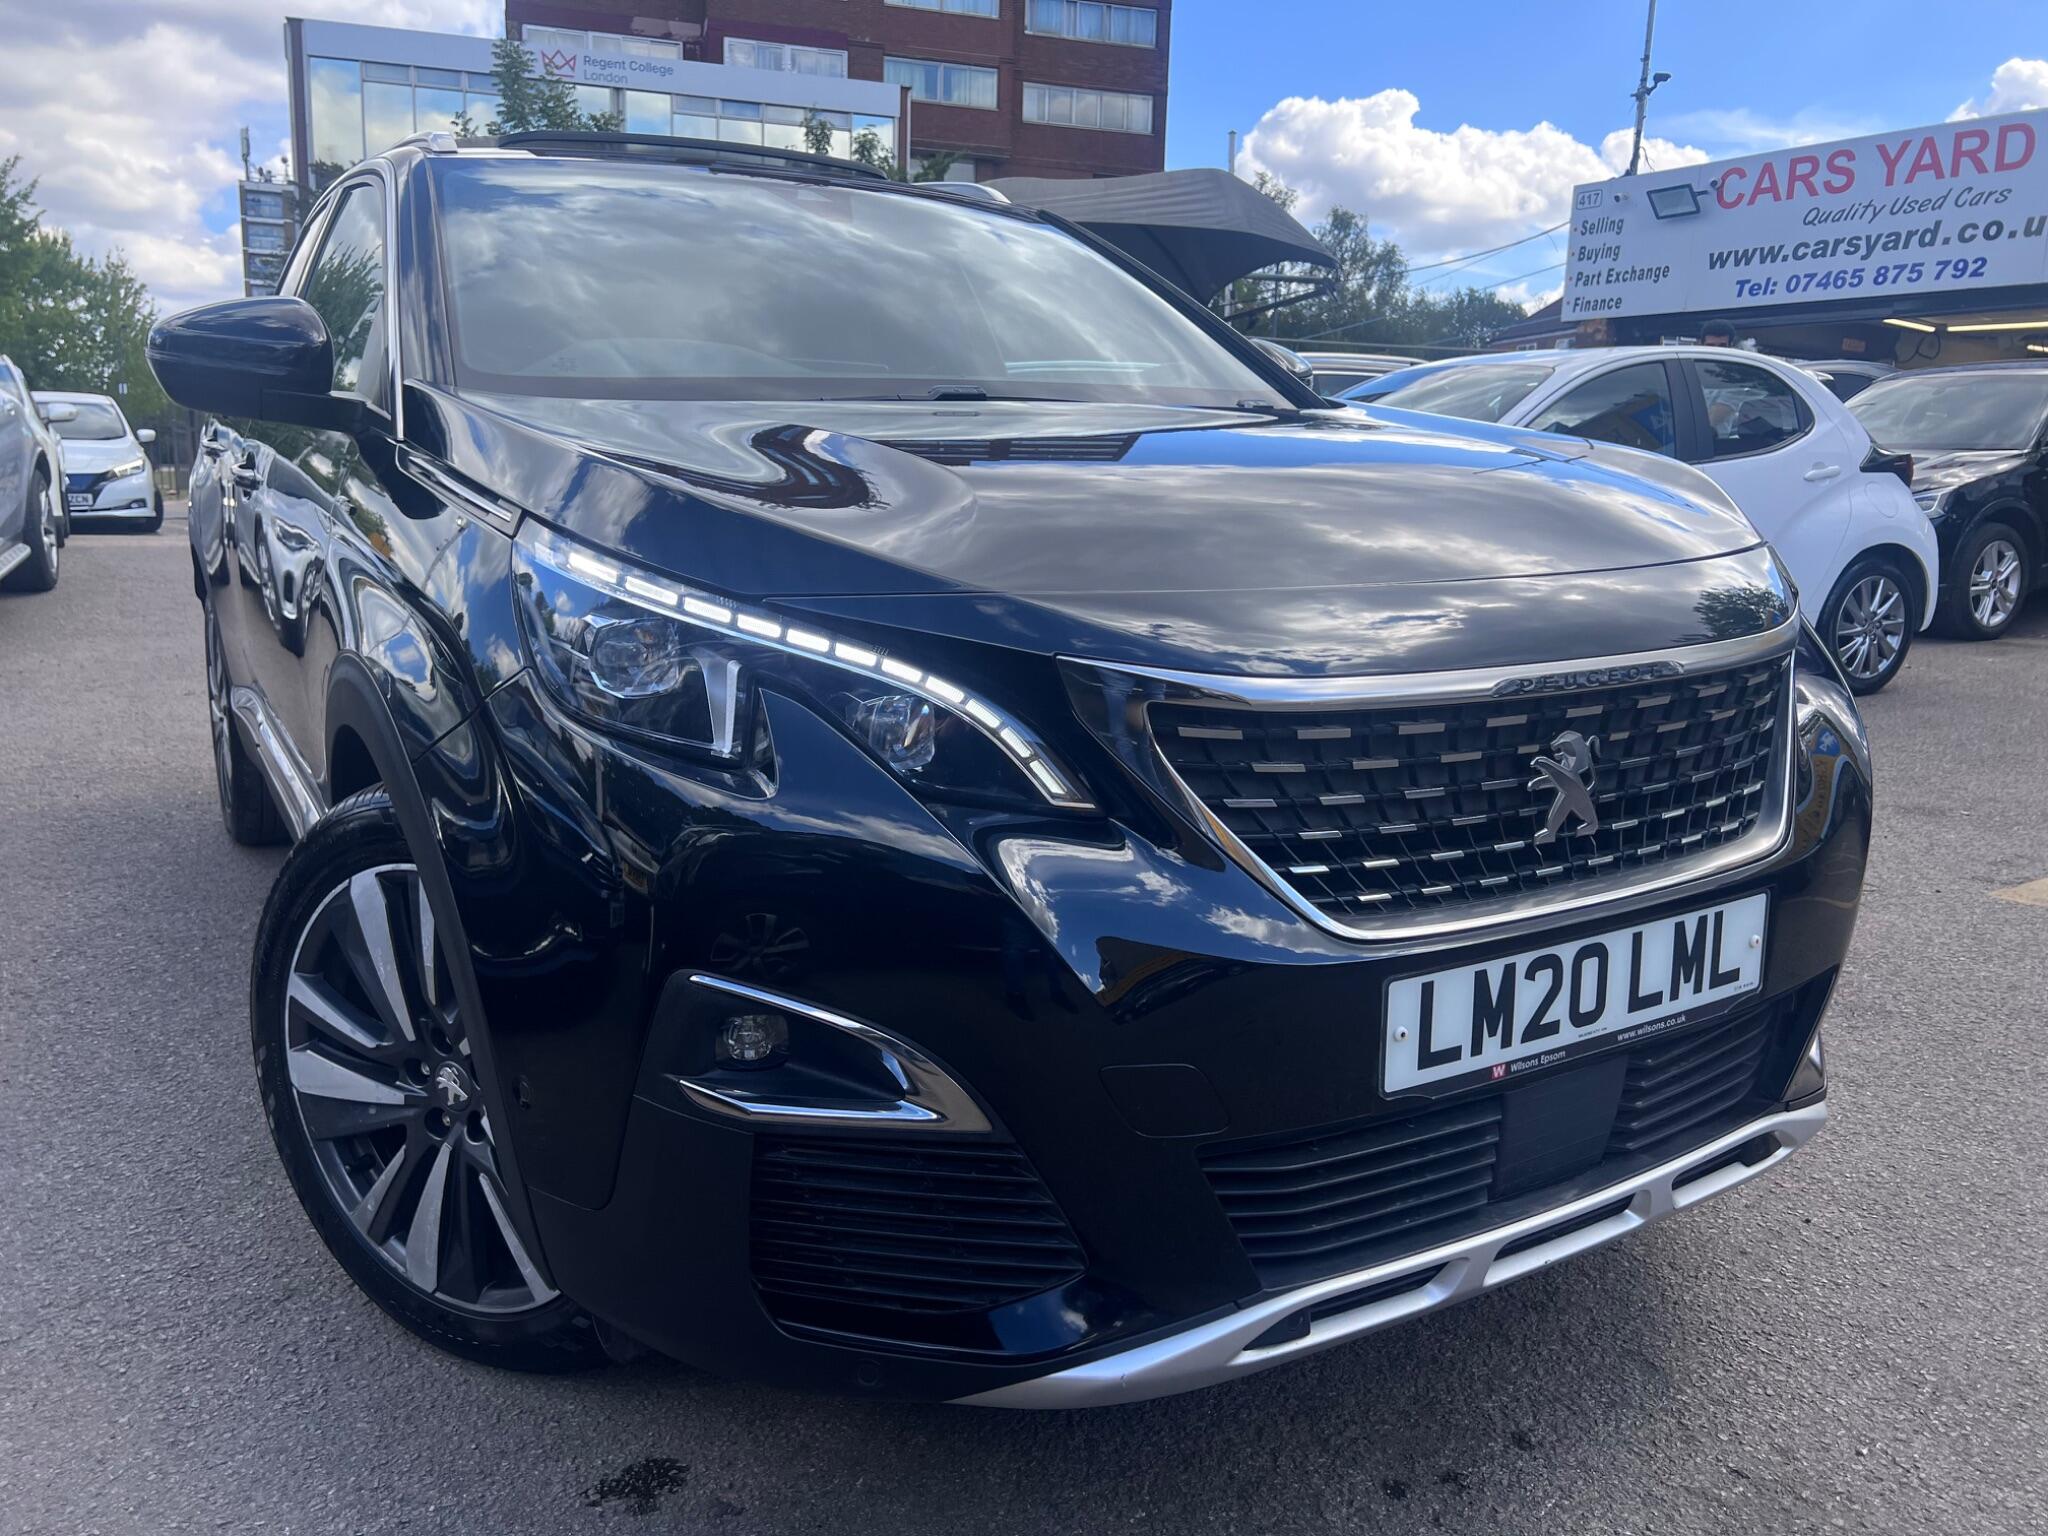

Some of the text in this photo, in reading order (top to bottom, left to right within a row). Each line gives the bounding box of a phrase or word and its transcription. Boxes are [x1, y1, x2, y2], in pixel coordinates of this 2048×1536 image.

[583, 55, 674, 76] Regent College
[584, 70, 628, 84] London
[1716, 123, 2036, 209] CARS YARD
[1578, 193, 1600, 206] 417
[1803, 186, 2013, 226] Quality Used Cars
[1580, 217, 1624, 236] Selling
[1577, 243, 1621, 264] Buying
[1574, 265, 1670, 287] Part Exchange
[1736, 257, 1987, 298] Tel: 07465 875 792
[1572, 296, 1622, 313] Finance
[1519, 665, 1662, 692] PEUGEOT
[1417, 910, 1741, 1070] LM20 LML
[1617, 1014, 1686, 1042] www.wilsons.co.uk
[1510, 1058, 1539, 1073] Wilsons
[1540, 1050, 1566, 1065] Epsom
